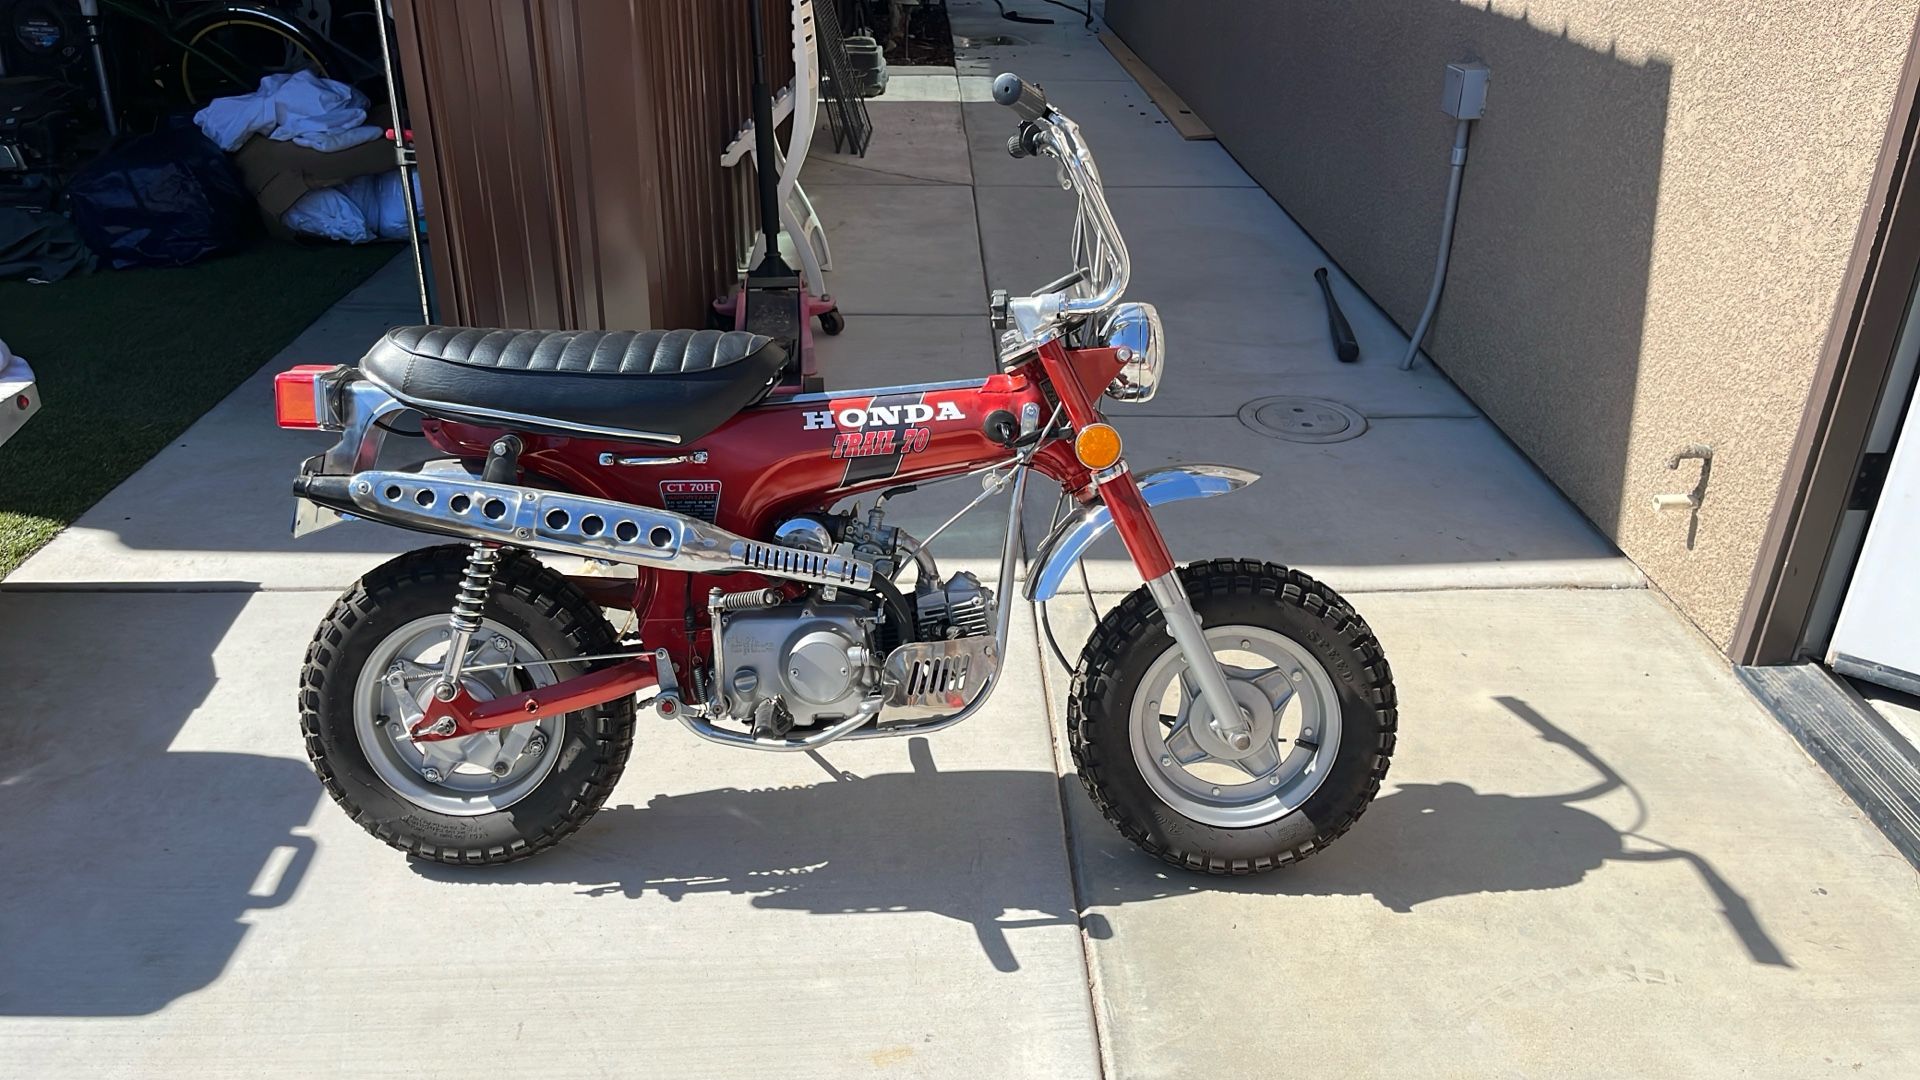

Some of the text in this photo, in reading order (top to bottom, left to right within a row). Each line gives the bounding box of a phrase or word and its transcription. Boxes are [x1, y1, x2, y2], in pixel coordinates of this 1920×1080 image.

[802, 401, 966, 430] HONDA
[832, 427, 931, 458] TRAIL 70
[666, 483, 715, 492] CT 70H
